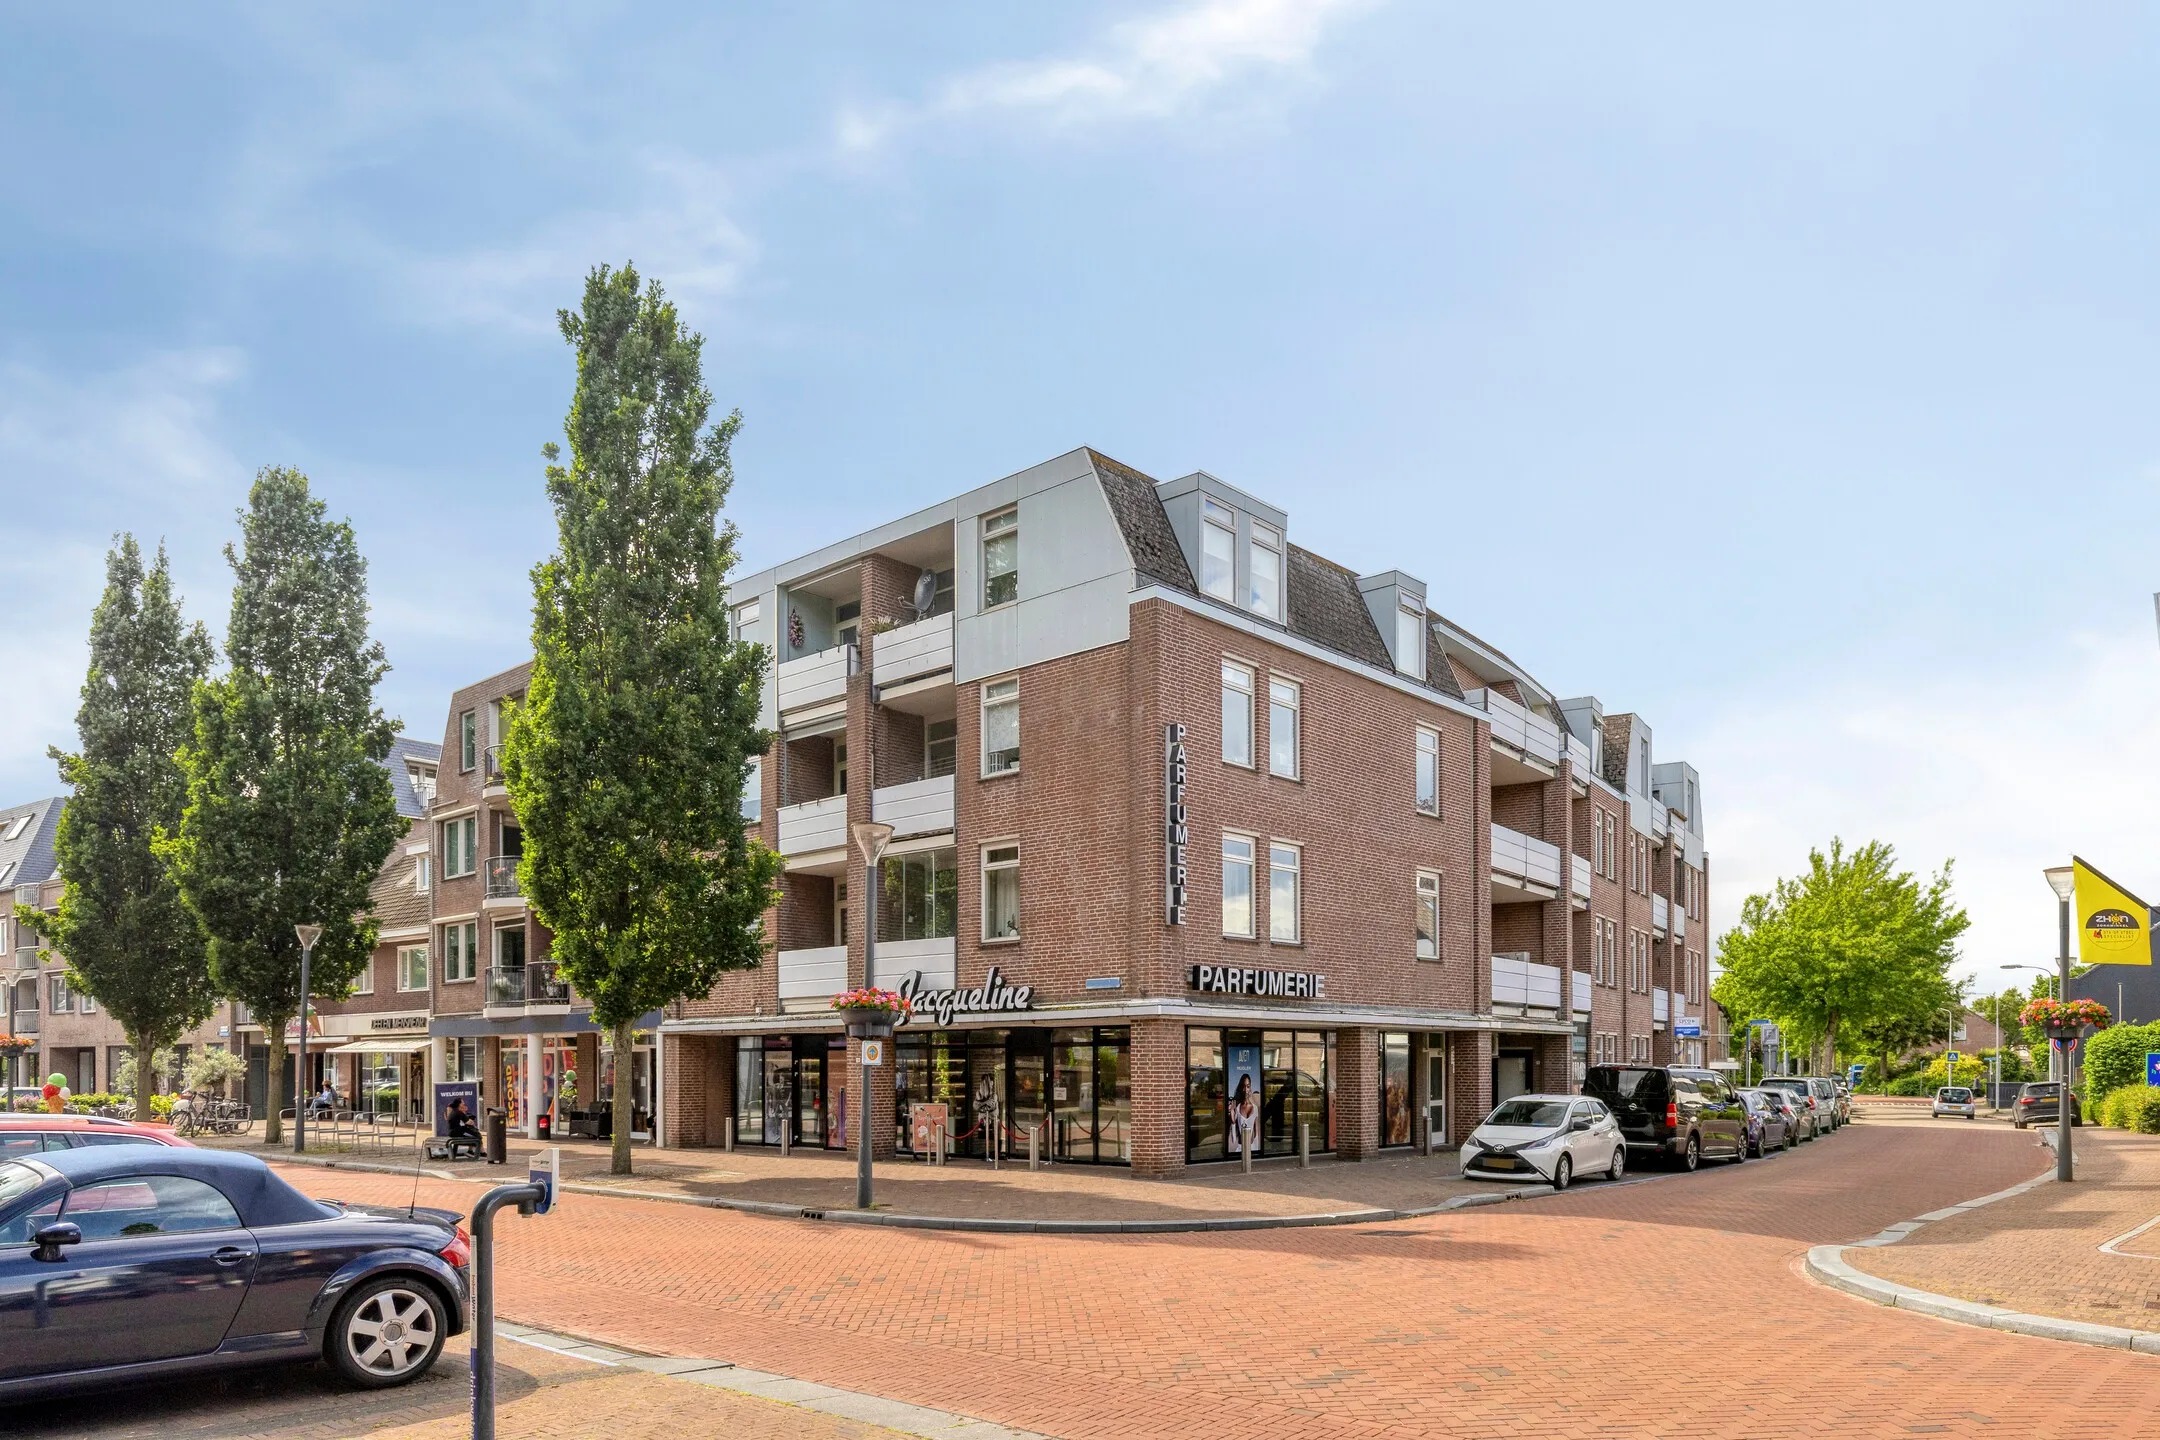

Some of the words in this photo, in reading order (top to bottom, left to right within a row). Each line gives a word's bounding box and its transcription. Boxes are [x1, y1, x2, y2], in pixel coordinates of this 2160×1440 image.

[1172, 723, 1187, 925] PARFUMERIE
[894, 966, 1032, 1026] Jacqueline
[1196, 965, 1326, 998] PARFUMERIE
[505, 1064, 516, 1127] SECOND
